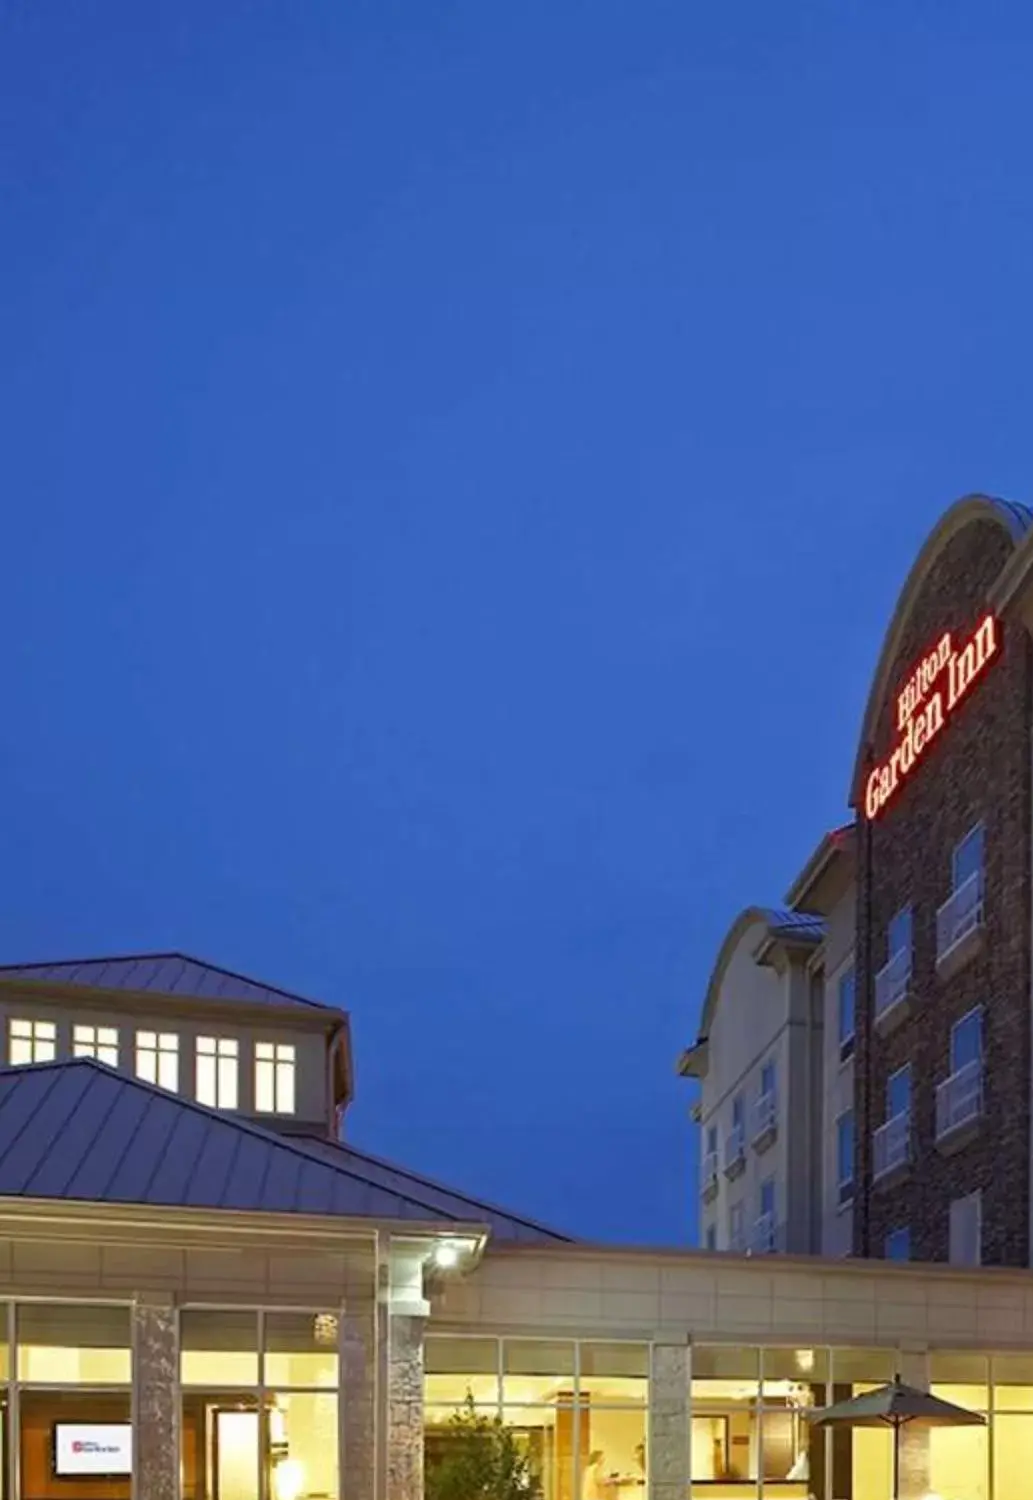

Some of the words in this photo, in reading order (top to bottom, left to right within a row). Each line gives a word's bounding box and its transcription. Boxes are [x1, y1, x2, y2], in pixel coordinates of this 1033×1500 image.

[865, 692, 944, 819] Garden
[947, 615, 996, 710] Inn
[897, 632, 951, 731] Hilton
